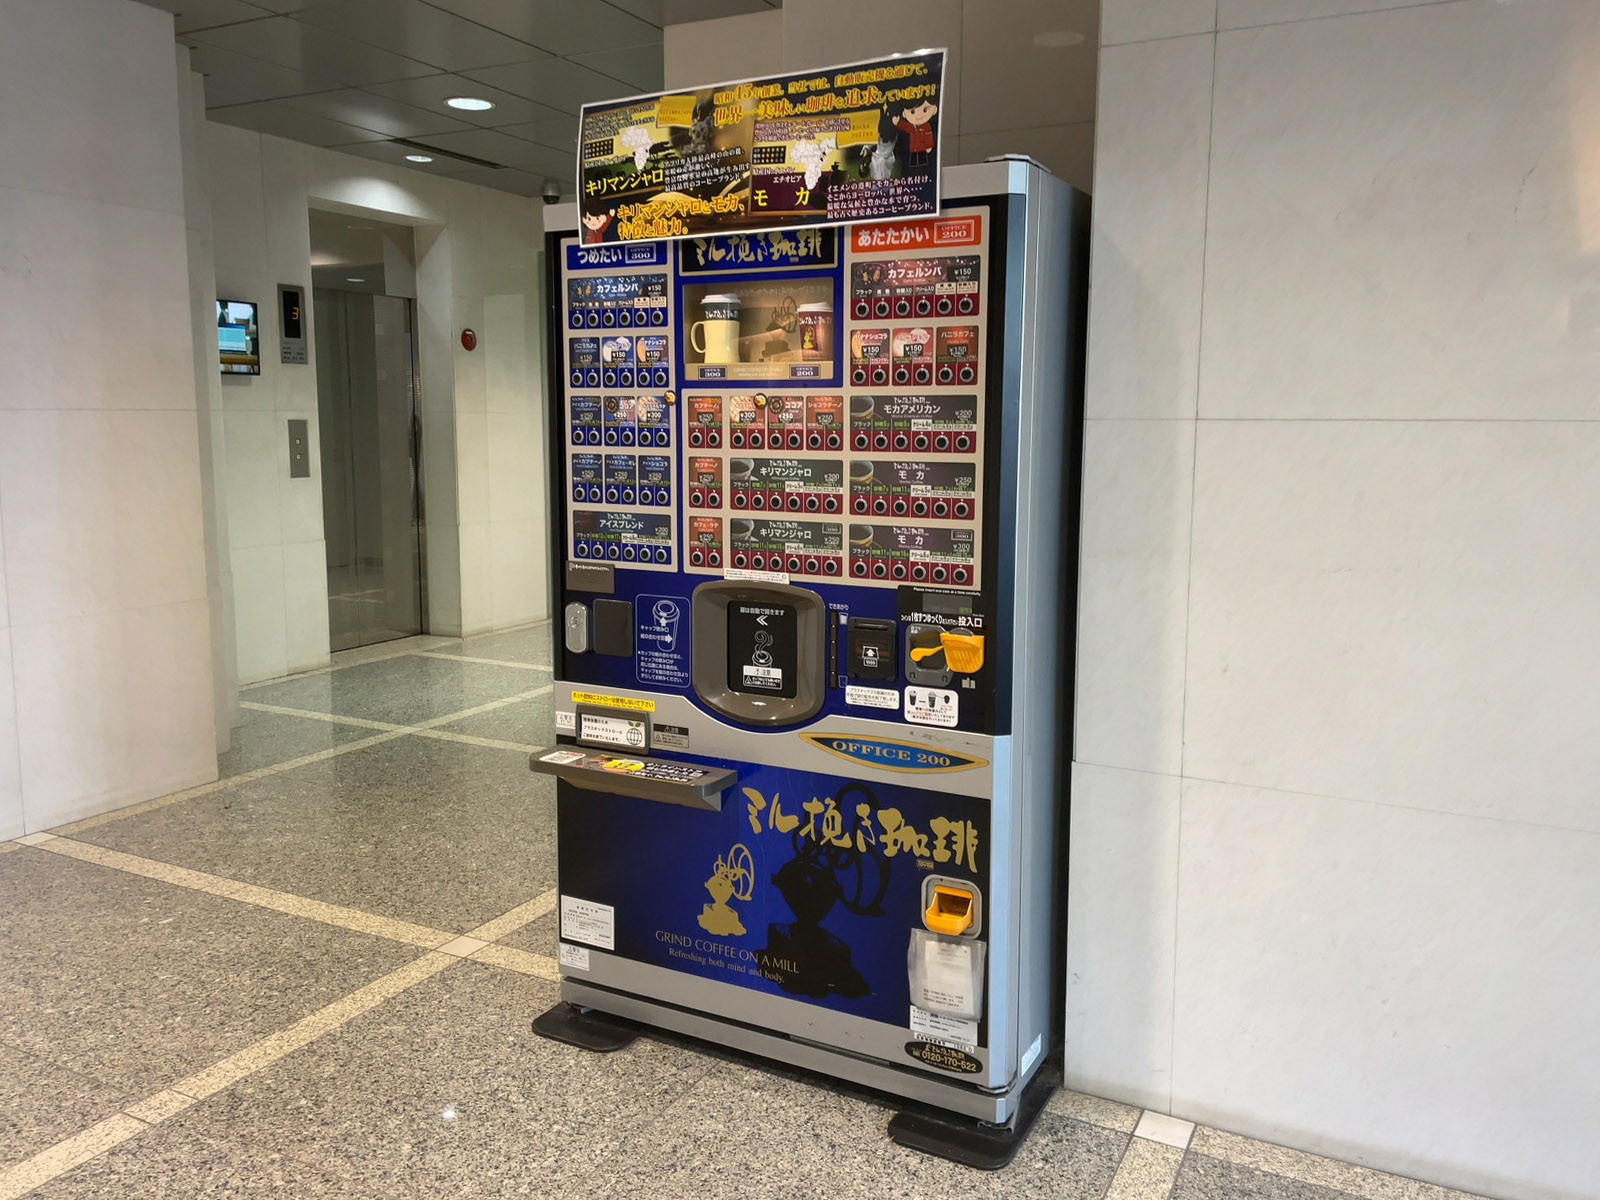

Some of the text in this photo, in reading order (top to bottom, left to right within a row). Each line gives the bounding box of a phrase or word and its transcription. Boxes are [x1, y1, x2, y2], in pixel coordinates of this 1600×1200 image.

[585, 169, 663, 196] キリマンジャロ
[754, 186, 810, 206] モ カ
[858, 227, 930, 246] あたたかい
[942, 231, 967, 239] 200
[577, 248, 623, 265] つめたい
[631, 252, 650, 260] 300
[888, 267, 942, 279] カフェルンバ
[597, 283, 639, 293] カフェルンバ
[856, 288, 873, 296] ブラック
[291, 307, 300, 321] 3
[884, 405, 941, 414] モカアメリカン
[760, 468, 812, 477] キリマンジャロ
[898, 470, 925, 480] モ カ
[599, 520, 644, 530] アイスブレンド
[760, 529, 812, 539] キリマンジャロ
[897, 535, 924, 545] モ カ
[958, 616, 983, 628] 投入口
[832, 740, 951, 768] OFFICE 200
[655, 930, 800, 974] GRIND COFFEE ON A MILL
[669, 947, 707, 966] Refreshing
[708, 956, 724, 968] both
[727, 961, 746, 973] mind
[748, 966, 762, 977] and
[921, 1050, 977, 1072] 0120-170-522
